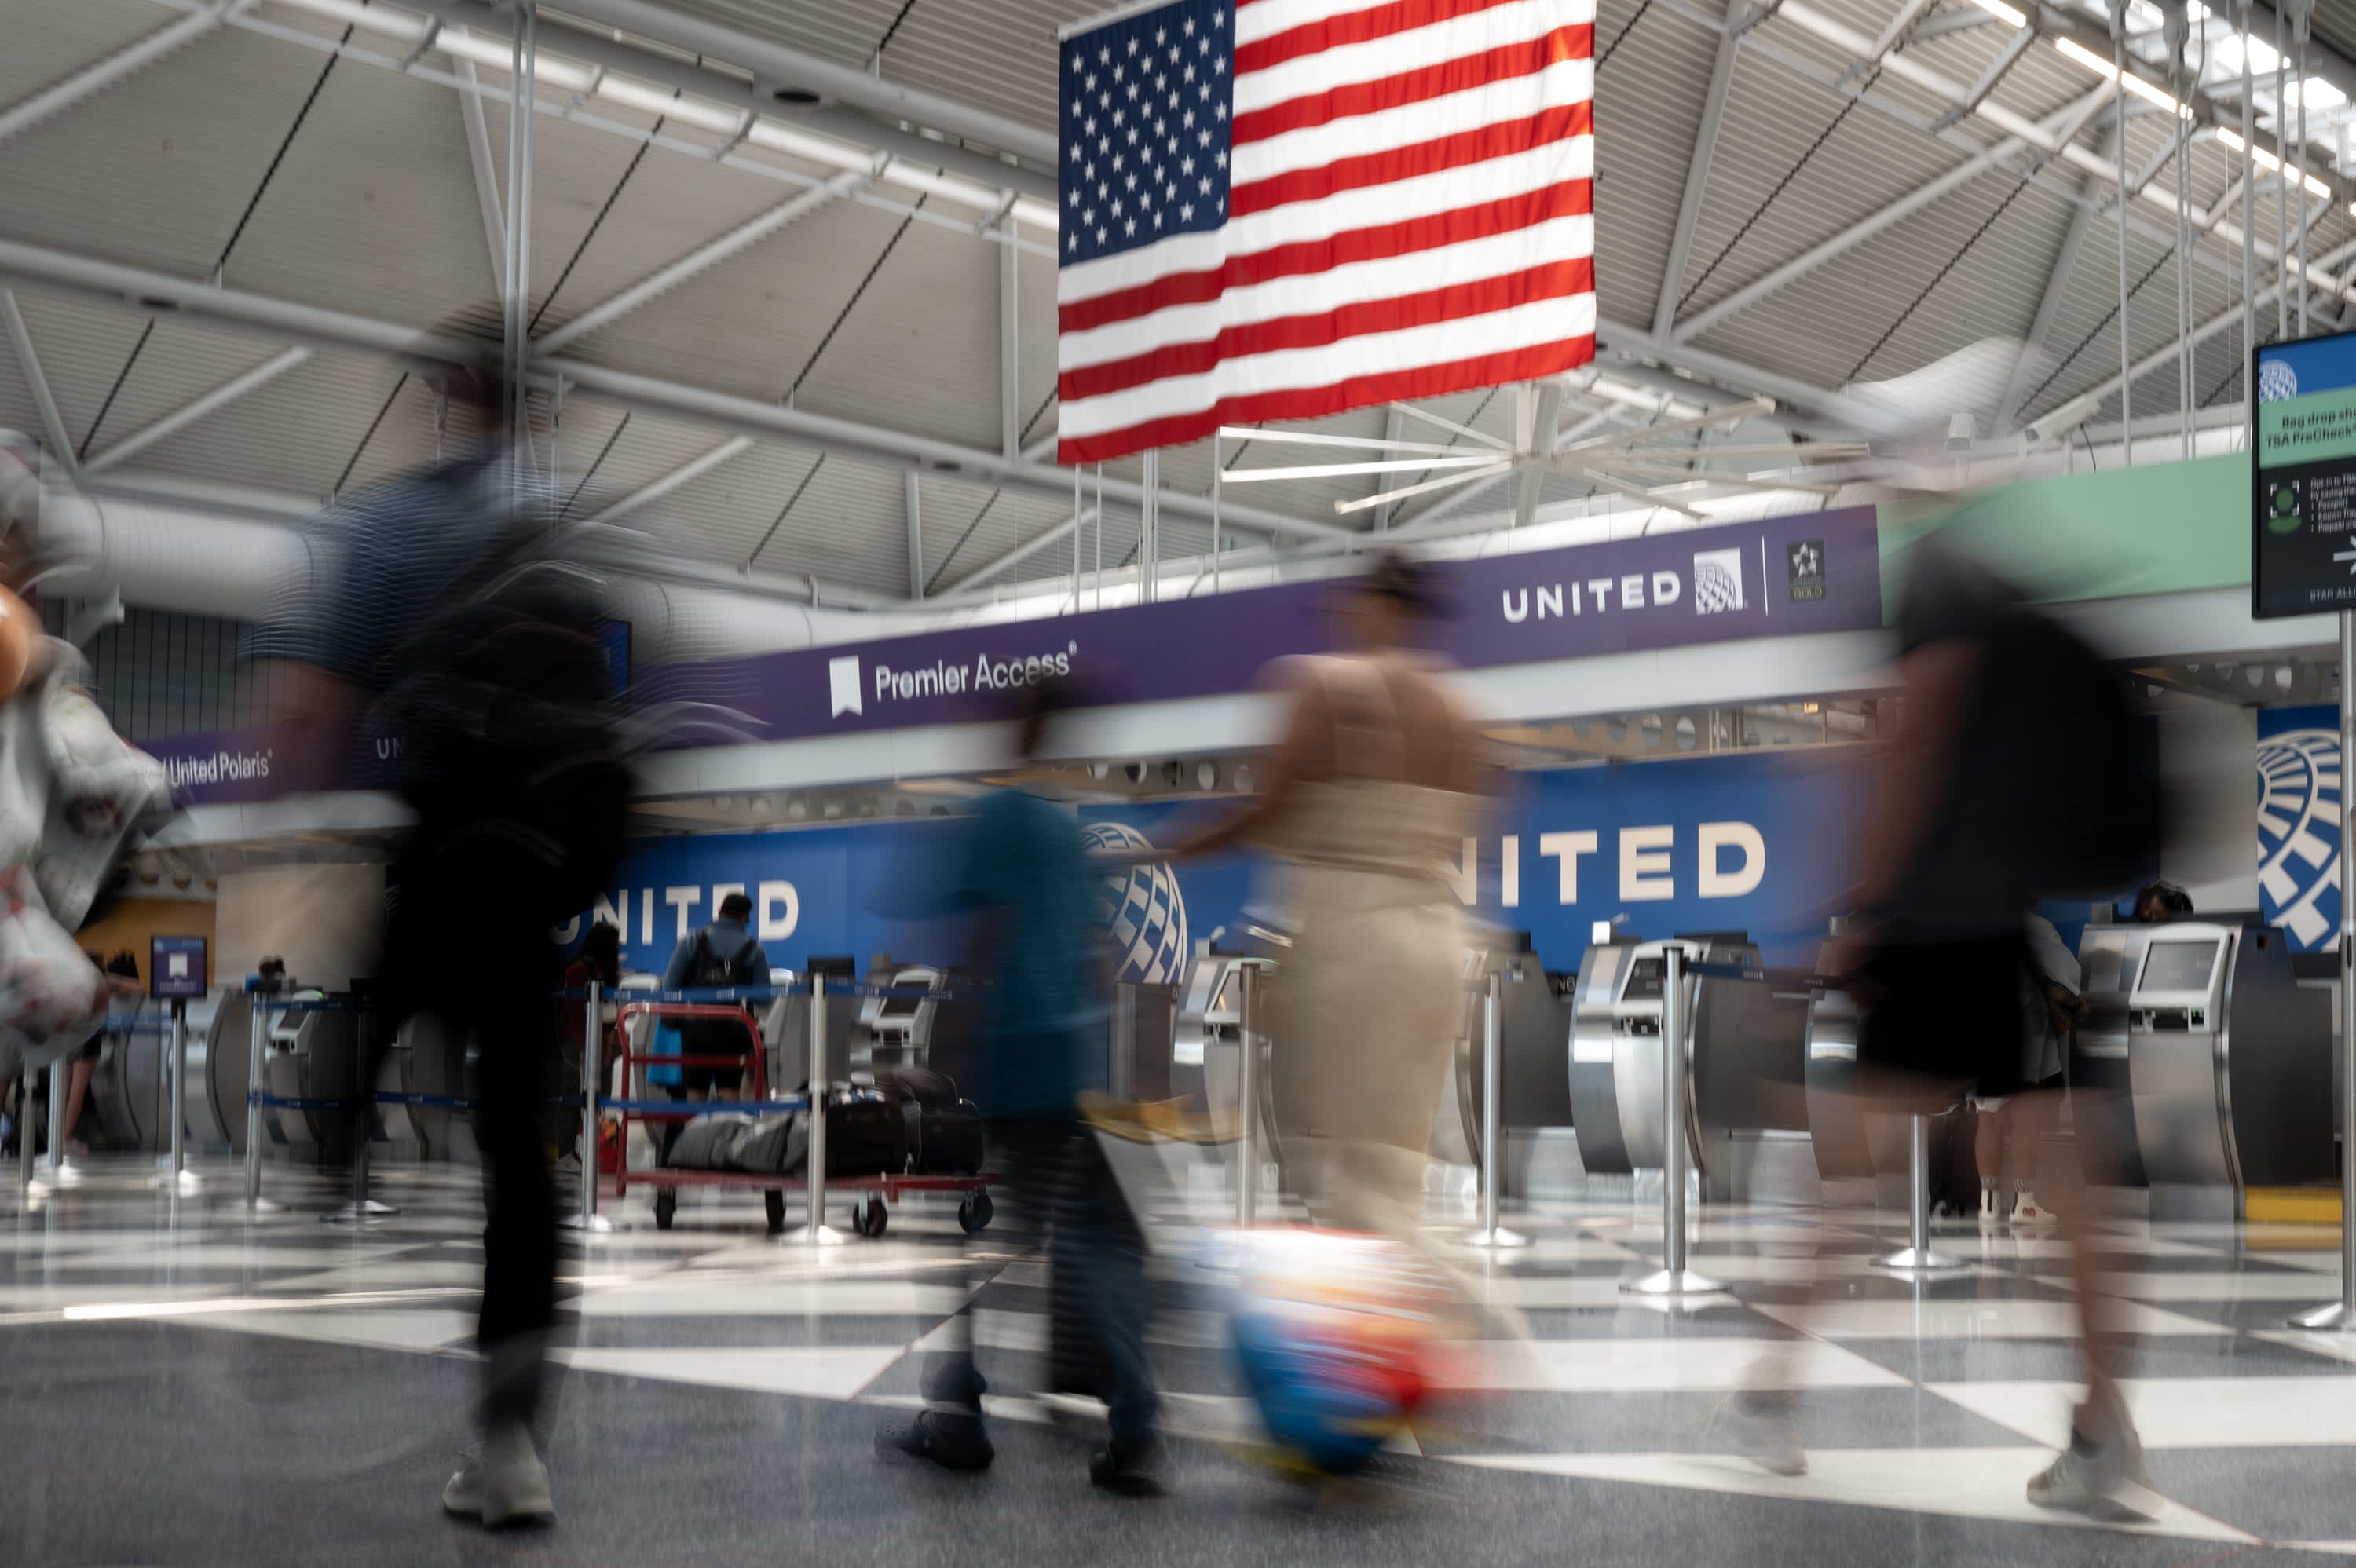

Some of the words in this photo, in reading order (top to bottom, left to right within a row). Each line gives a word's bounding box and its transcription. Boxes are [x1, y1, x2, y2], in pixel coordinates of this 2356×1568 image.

[2307, 411, 2336, 426] drop
[2267, 433, 2289, 450] TSA
[1502, 569, 1681, 624] UNITED
[876, 658, 969, 703] Premier
[169, 751, 218, 788] United
[1443, 820, 1767, 907] NITED
